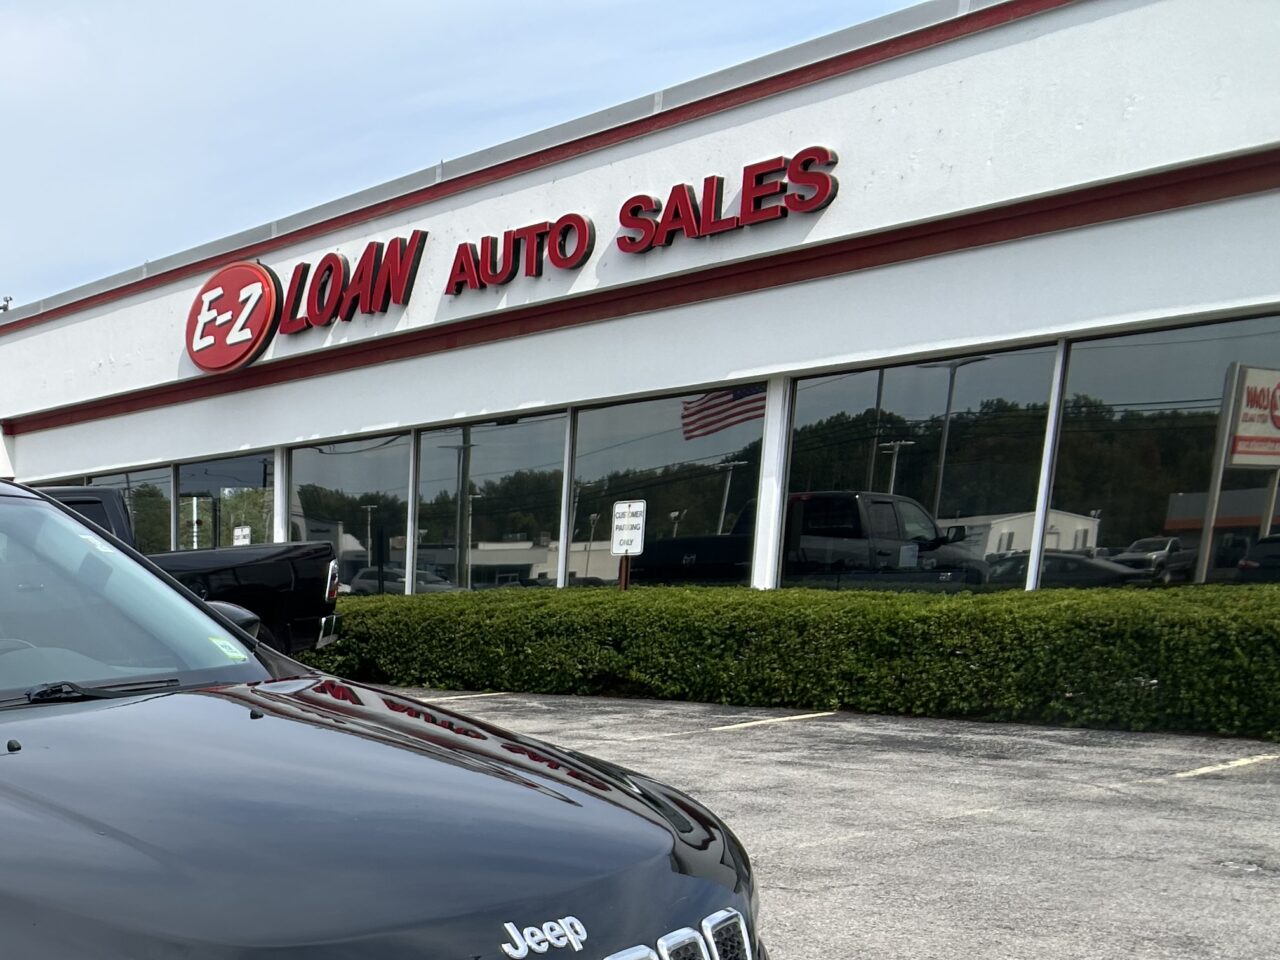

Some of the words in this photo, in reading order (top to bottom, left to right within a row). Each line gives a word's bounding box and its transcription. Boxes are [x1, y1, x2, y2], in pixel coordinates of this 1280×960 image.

[192, 282, 263, 352] E-Z
[279, 229, 429, 335] LOAN
[445, 212, 596, 296] AUTO
[617, 145, 839, 254] SALES
[615, 510, 643, 519] CUSTOMER
[501, 916, 588, 960] Jeep
